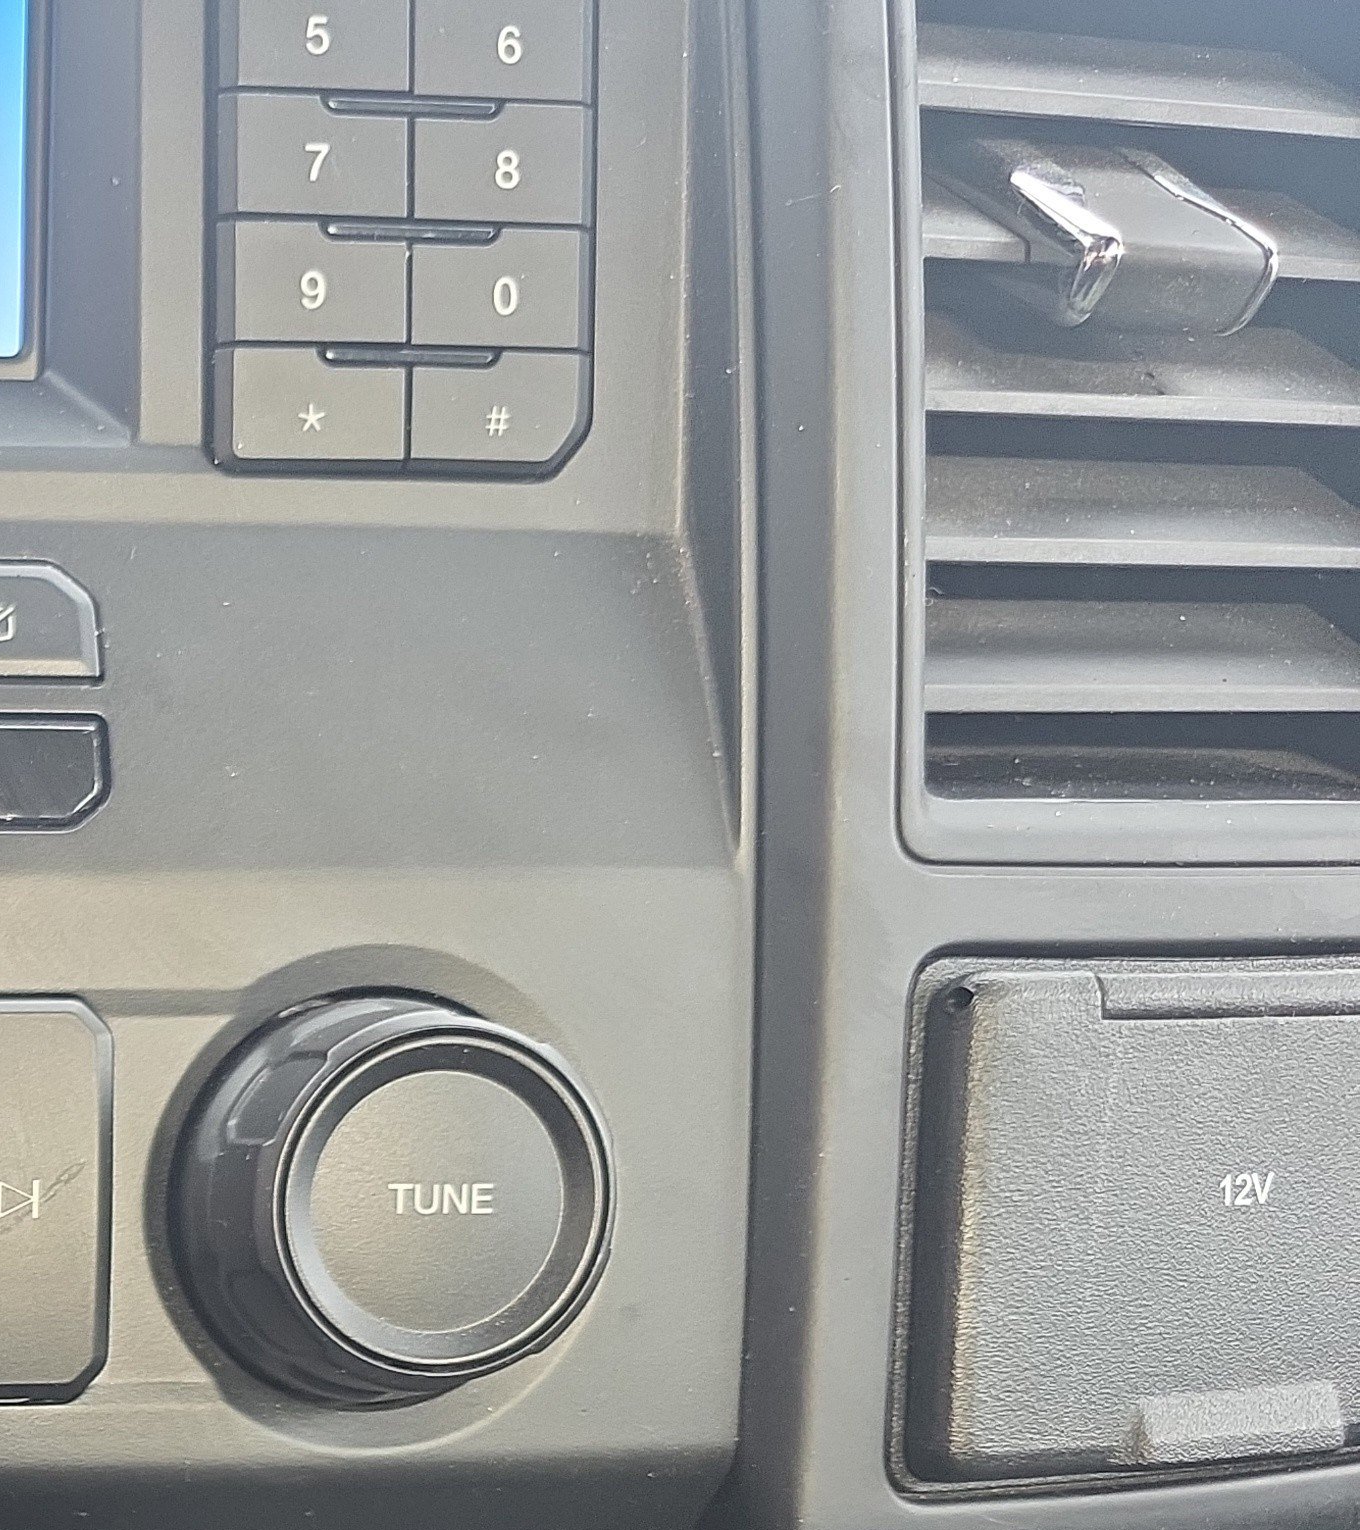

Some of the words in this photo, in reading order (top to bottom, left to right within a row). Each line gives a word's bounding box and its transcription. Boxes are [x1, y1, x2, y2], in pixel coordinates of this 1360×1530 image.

[305, 15, 331, 55] 5
[496, 25, 523, 64] 6
[304, 143, 330, 182] 7
[494, 149, 521, 190] 8
[299, 270, 326, 310] 9
[492, 276, 519, 316] 0
[388, 1182, 494, 1216] TUNE
[1219, 1172, 1274, 1206] 12V
